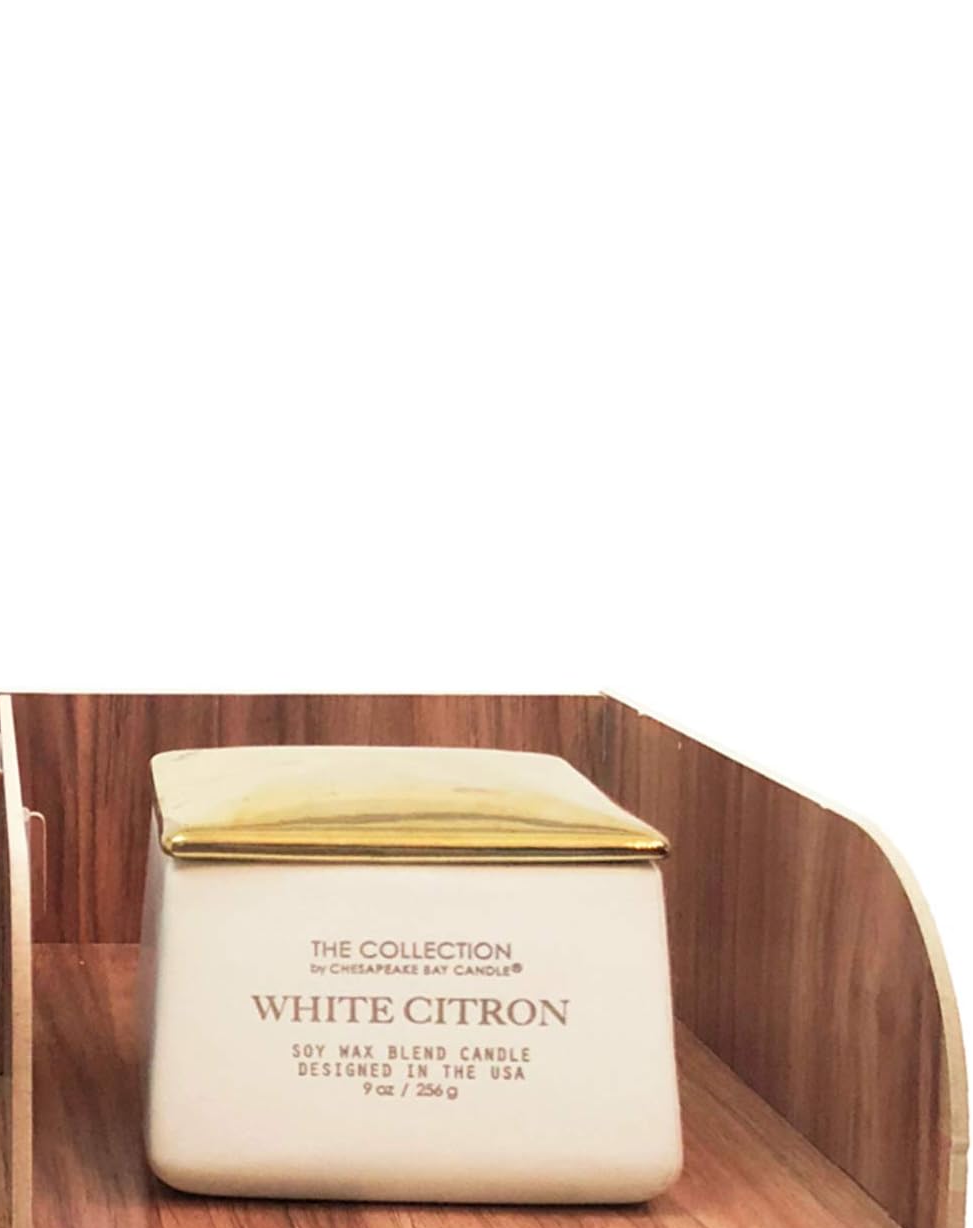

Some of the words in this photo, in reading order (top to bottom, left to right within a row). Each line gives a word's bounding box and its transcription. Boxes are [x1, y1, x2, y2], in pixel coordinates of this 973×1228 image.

[311, 940, 351, 959] THE
[359, 940, 512, 960] COLLECTION
[310, 963, 326, 976] by
[329, 963, 418, 975] CHESAPEAKE
[423, 964, 449, 976] BAY
[251, 994, 395, 1024] WHITE
[403, 996, 571, 1027] CITRON
[291, 1043, 326, 1059] SOY
[339, 1044, 374, 1059] WAX
[388, 1045, 447, 1061] BLEND
[460, 1046, 531, 1063] CANDLE
[298, 1062, 392, 1078] DESIGNED
[406, 1063, 428, 1079] IN
[442, 1064, 477, 1080] THE
[490, 1065, 525, 1081] USA
[363, 1082, 373, 1097] 9
[376, 1085, 395, 1097] oz
[416, 1082, 444, 1097] 256
[446, 1085, 459, 1101] g
